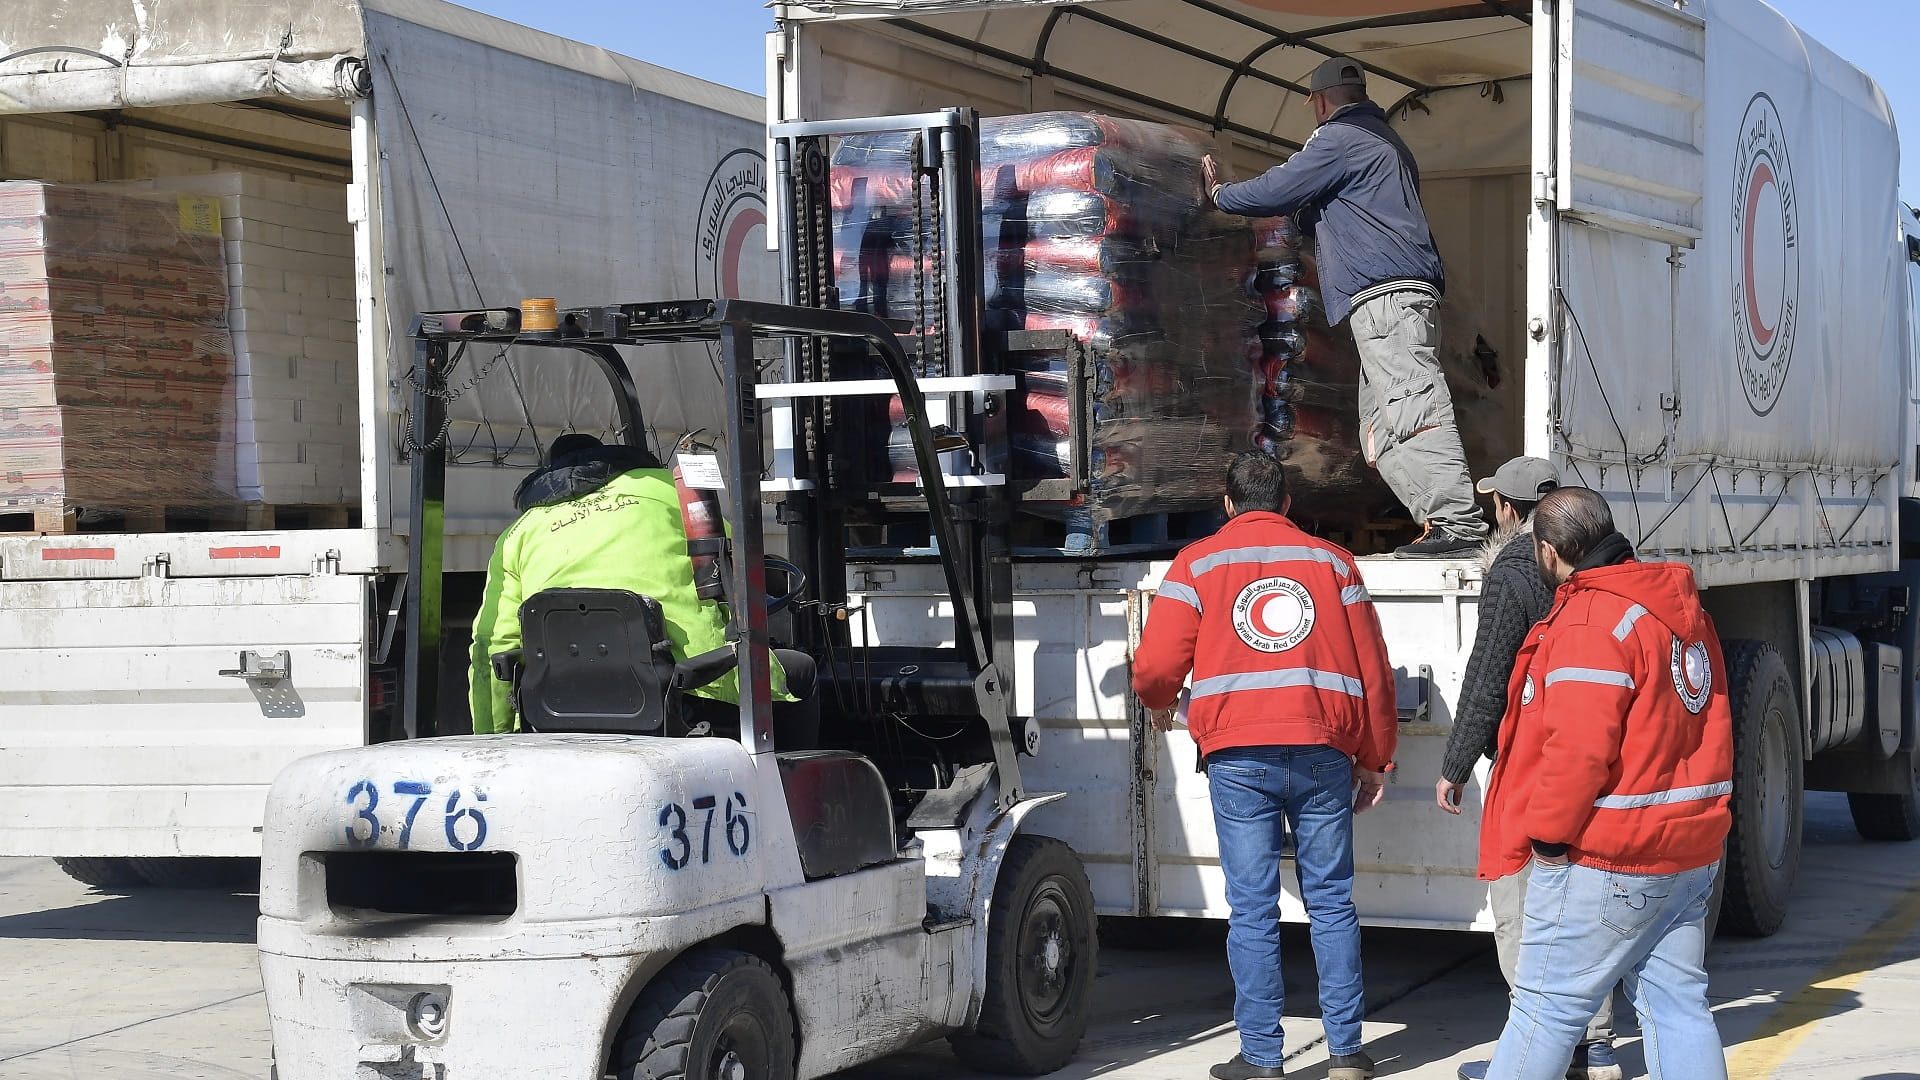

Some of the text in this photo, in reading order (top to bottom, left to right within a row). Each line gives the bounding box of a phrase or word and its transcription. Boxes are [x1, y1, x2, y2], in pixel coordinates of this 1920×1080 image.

[1748, 108, 1767, 154] العربي
[702, 161, 759, 262] العربي السوري
[1734, 282, 1793, 401] Syrian Arab Red Crescent
[595, 498, 640, 513] مديرية
[1236, 618, 1312, 650] Syrian Arab Red Crescent
[345, 779, 488, 851] 376
[660, 790, 750, 870] 376
